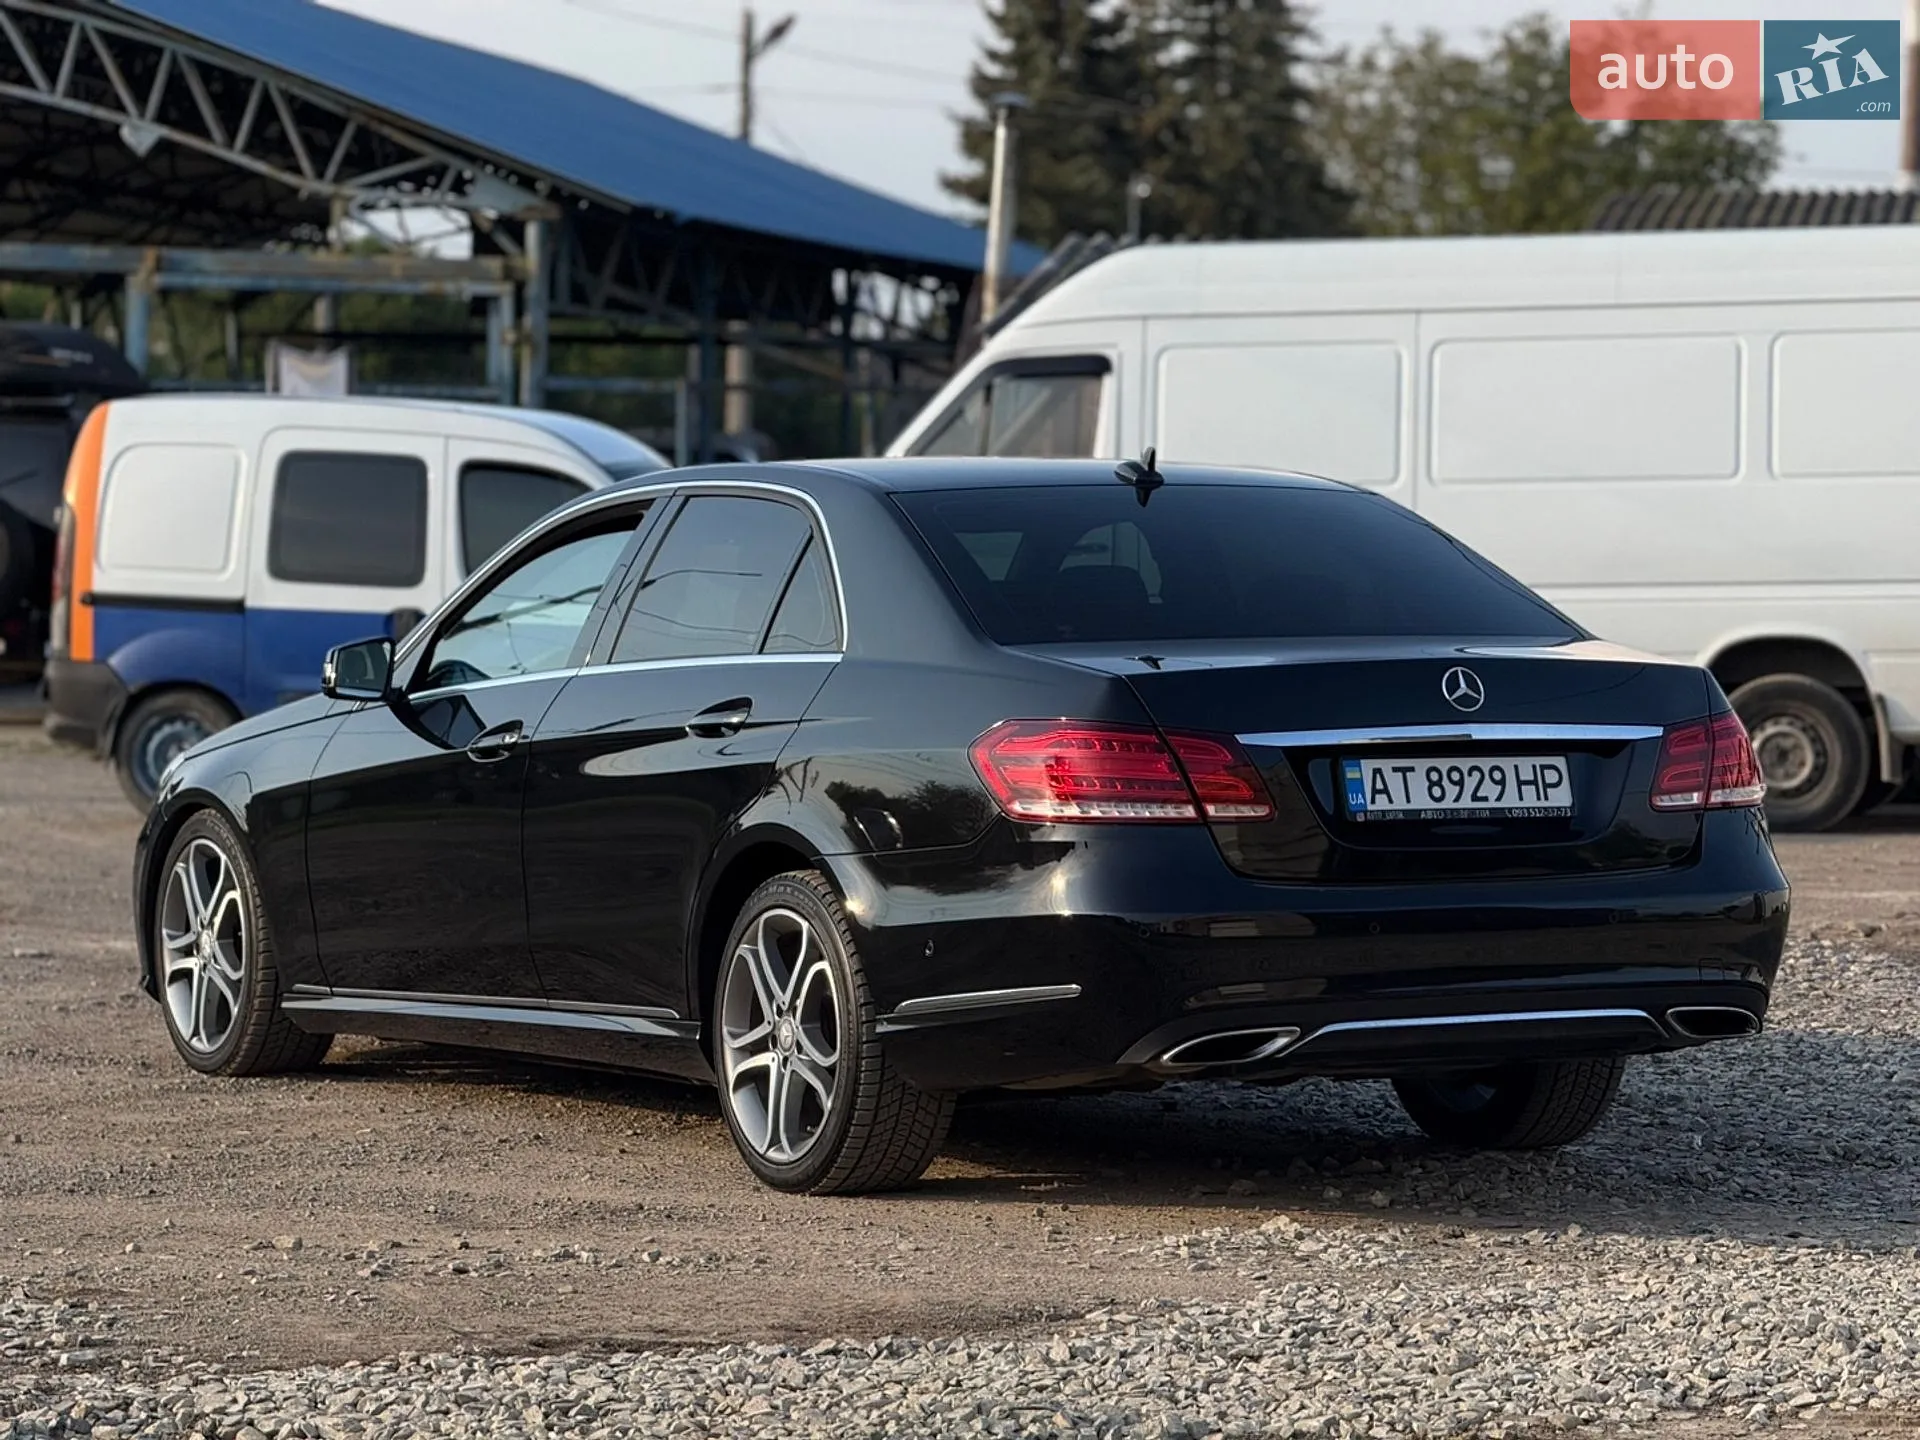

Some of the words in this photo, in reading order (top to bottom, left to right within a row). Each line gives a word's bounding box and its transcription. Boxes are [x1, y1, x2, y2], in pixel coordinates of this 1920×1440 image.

[1370, 766, 1416, 805] AT
[1425, 764, 1507, 804] 8929
[1513, 763, 1564, 802] HP
[1349, 793, 1366, 806] UA
[1511, 807, 1528, 818] 093
